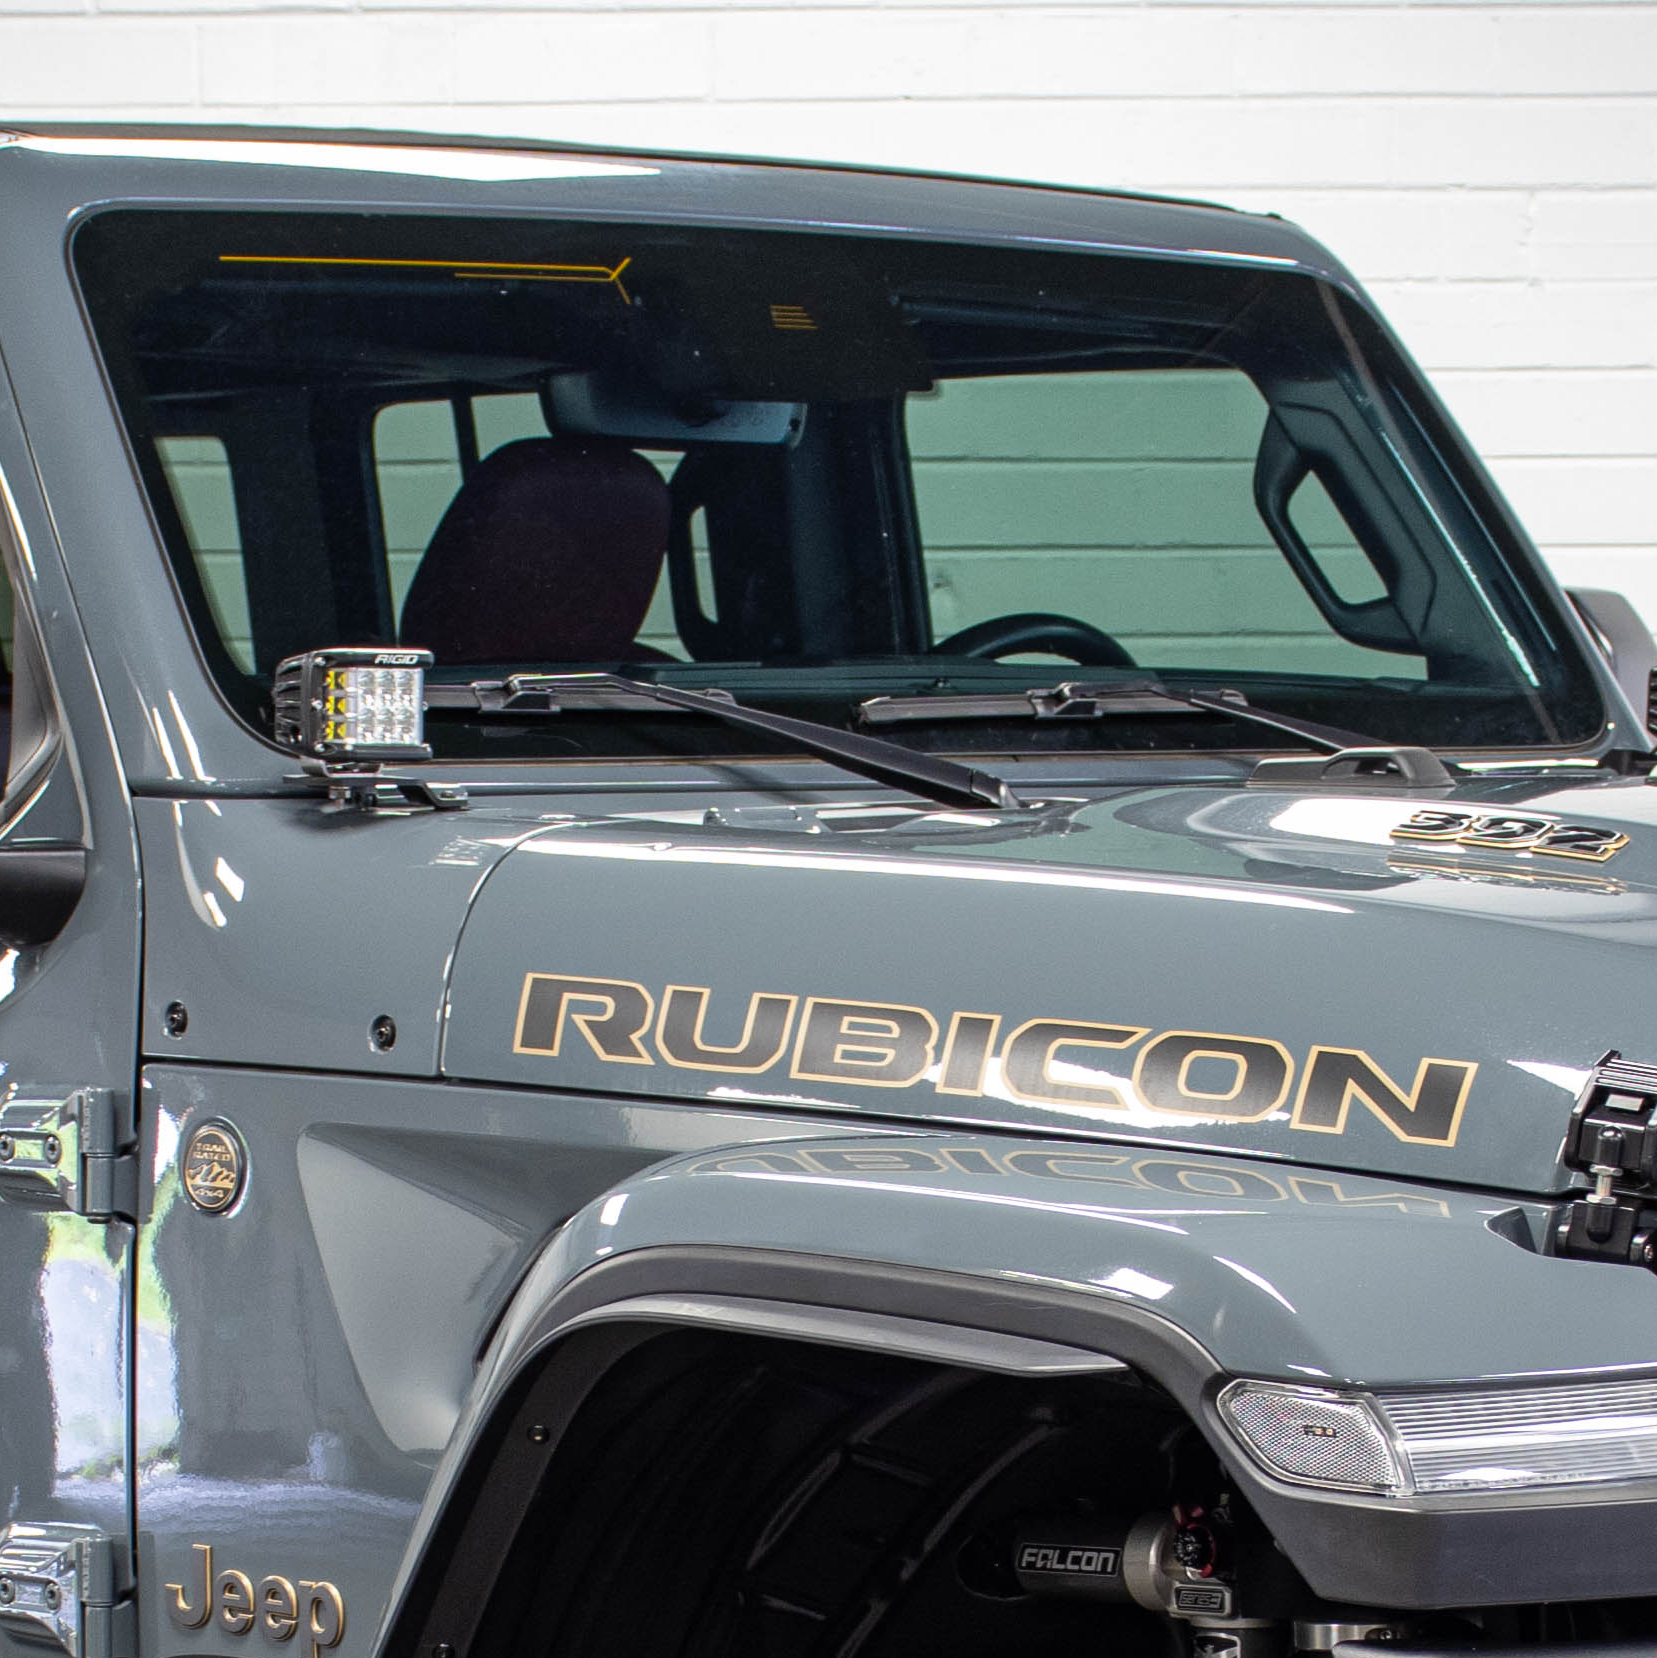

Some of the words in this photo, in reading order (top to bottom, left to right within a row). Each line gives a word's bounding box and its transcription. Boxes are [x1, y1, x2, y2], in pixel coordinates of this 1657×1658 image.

[375, 654, 420, 665] RIGID
[1389, 810, 1630, 863] 392
[513, 972, 1479, 1148] RUBICON
[1022, 1549, 1115, 1573] FALCON
